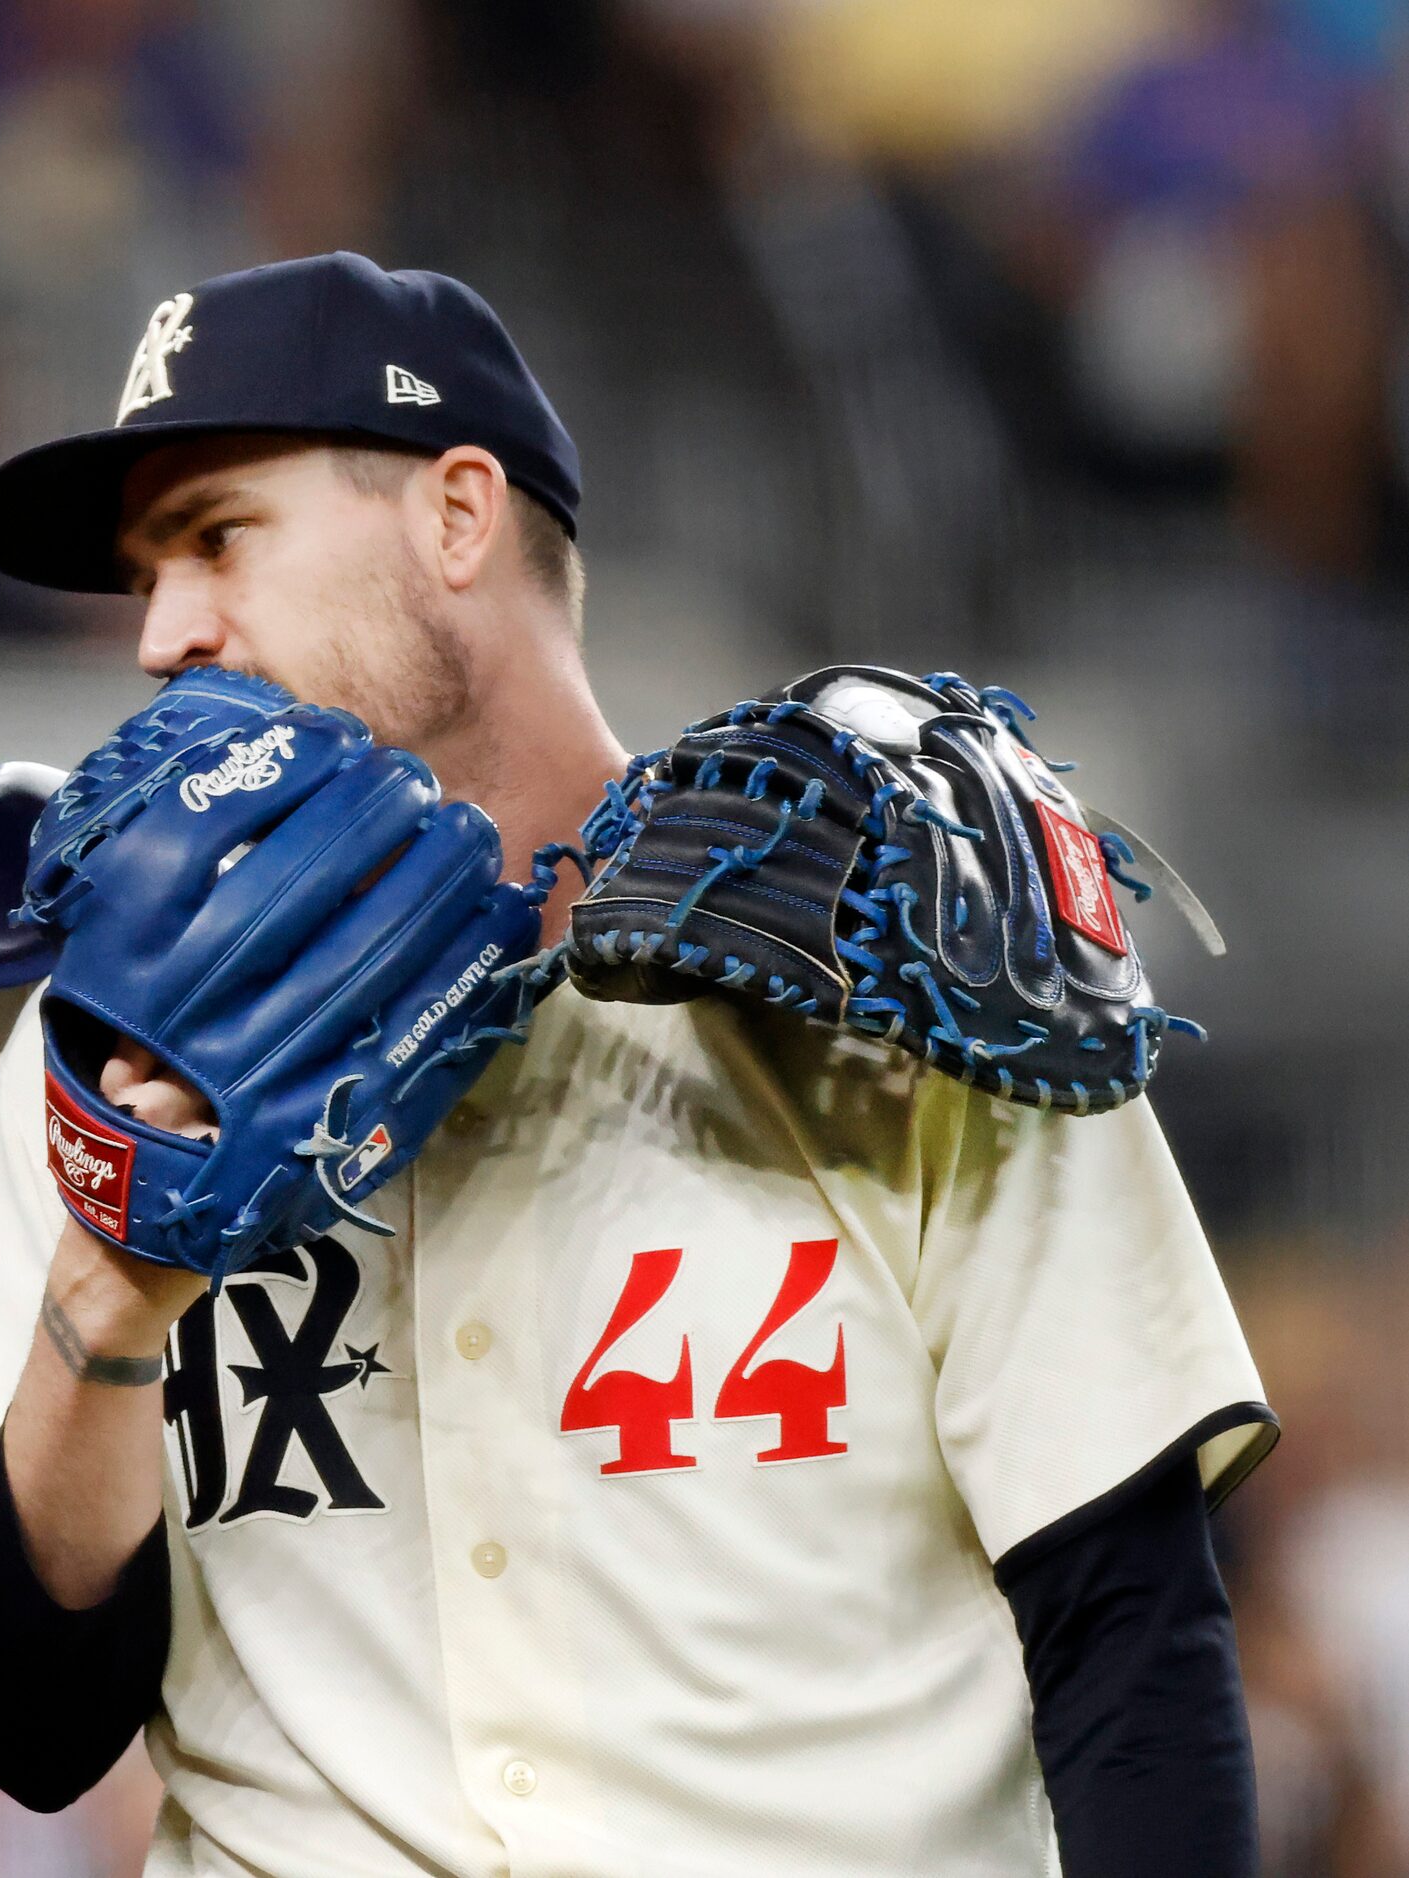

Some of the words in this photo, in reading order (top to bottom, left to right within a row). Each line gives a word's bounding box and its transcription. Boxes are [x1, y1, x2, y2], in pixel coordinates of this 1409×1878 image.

[179, 724, 296, 813] Rawlings
[386, 1034, 420, 1069] THE
[412, 1001, 448, 1041] GOLD
[445, 961, 488, 1008] GLOVE
[479, 943, 504, 967] CO.
[49, 1115, 118, 1190] Rawlings
[560, 1237, 849, 1477] 44
